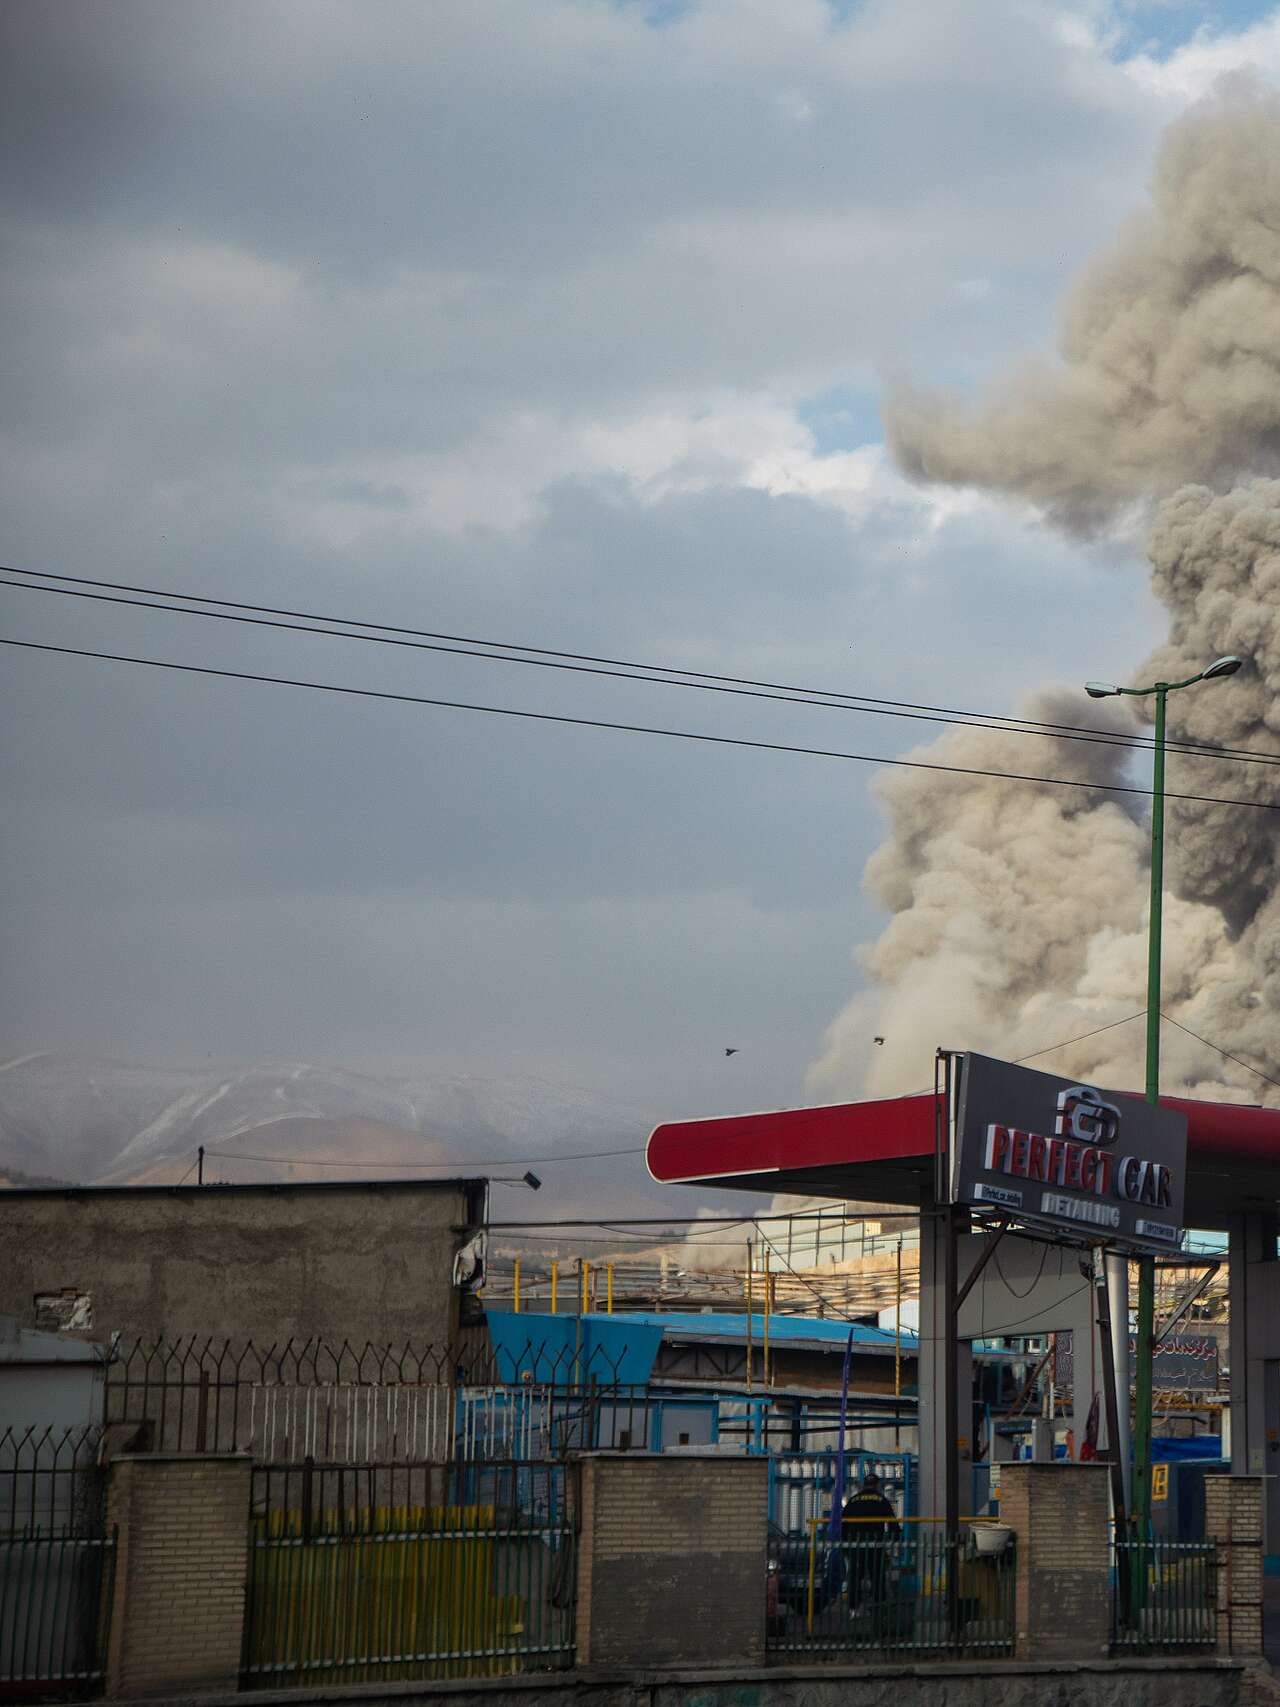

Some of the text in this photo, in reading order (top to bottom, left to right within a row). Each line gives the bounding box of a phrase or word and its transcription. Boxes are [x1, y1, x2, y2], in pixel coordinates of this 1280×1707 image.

[984, 1123, 1171, 1208] PERFECT CAR
[1040, 1192, 1120, 1228] DETAILING
